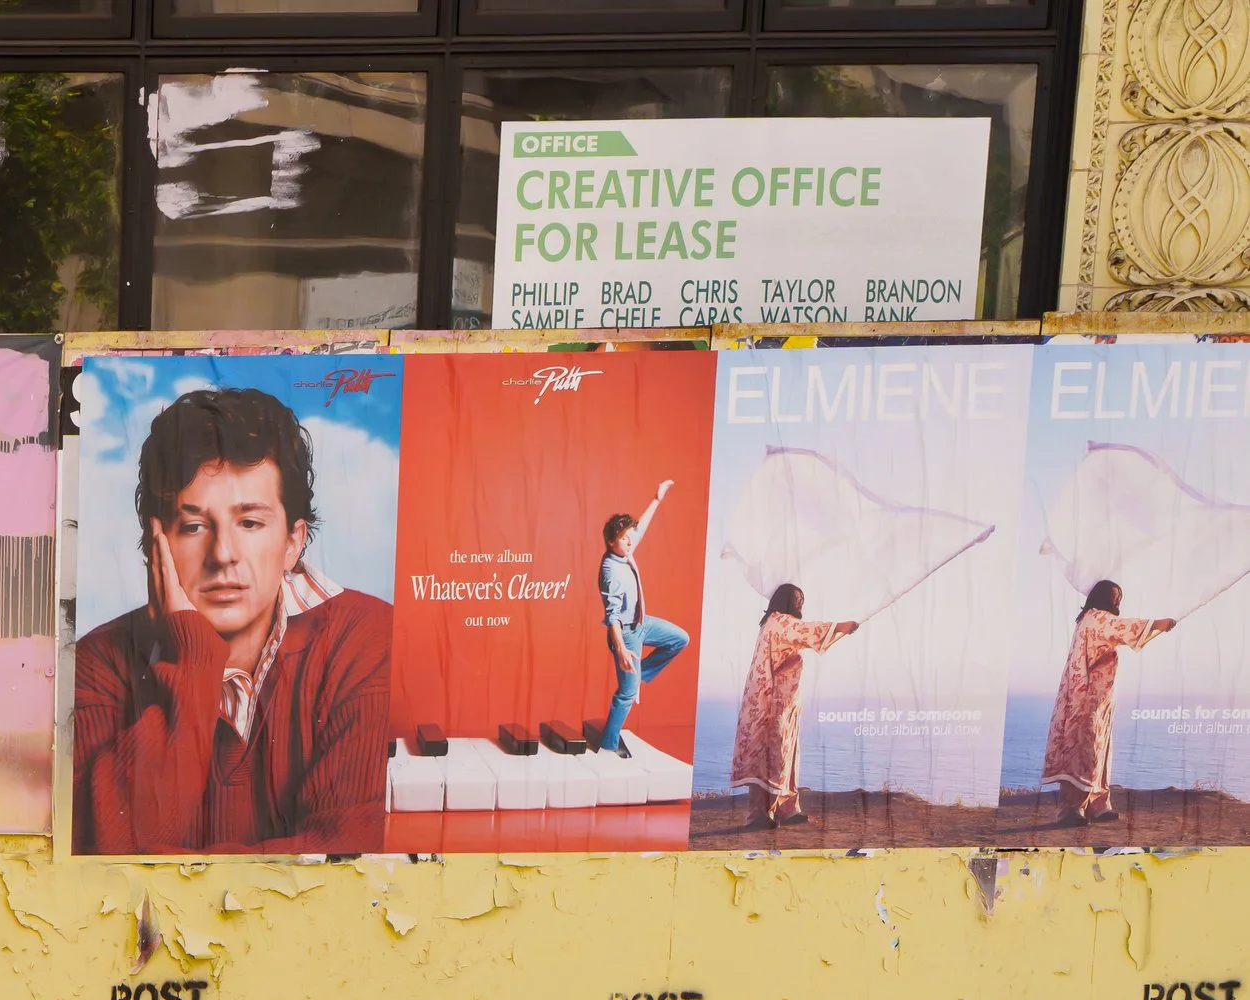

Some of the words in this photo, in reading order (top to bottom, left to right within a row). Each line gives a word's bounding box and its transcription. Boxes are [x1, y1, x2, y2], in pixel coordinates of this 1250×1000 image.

[521, 135, 598, 154] OFFICE
[516, 168, 715, 210] CREATIVE
[731, 166, 881, 206] OFFICE
[514, 222, 598, 262] FOR
[614, 220, 737, 261] LEASE
[511, 282, 579, 306] PHILLIP
[601, 281, 652, 305] BRAD
[681, 280, 738, 304] CHRIS
[762, 279, 835, 303] TAYLOR
[866, 279, 962, 303] BRANDON
[679, 306, 743, 326] CARAS
[760, 306, 847, 323] WATSON
[865, 306, 917, 322] BANK
[502, 378, 543, 386] charlie
[533, 366, 604, 405] Puth
[727, 363, 1005, 424] ELMIENE
[1051, 361, 1250, 419] ELMIE
[450, 550, 467, 563] the
[470, 552, 494, 563] new
[497, 550, 533, 562] album
[411, 573, 503, 600] Whatever's
[507, 573, 571, 600] Clever!
[465, 616, 483, 626] out
[487, 616, 510, 626] now
[818, 708, 875, 722] sounds
[880, 708, 903, 721] for
[907, 710, 982, 721] someone
[1131, 706, 1190, 720] sounds
[1194, 705, 1218, 719] for
[854, 725, 888, 736] debut
[892, 723, 929, 736] album
[934, 724, 951, 735] out
[954, 724, 982, 734] now
[1167, 722, 1202, 734] debut
[1205, 721, 1243, 733] album
